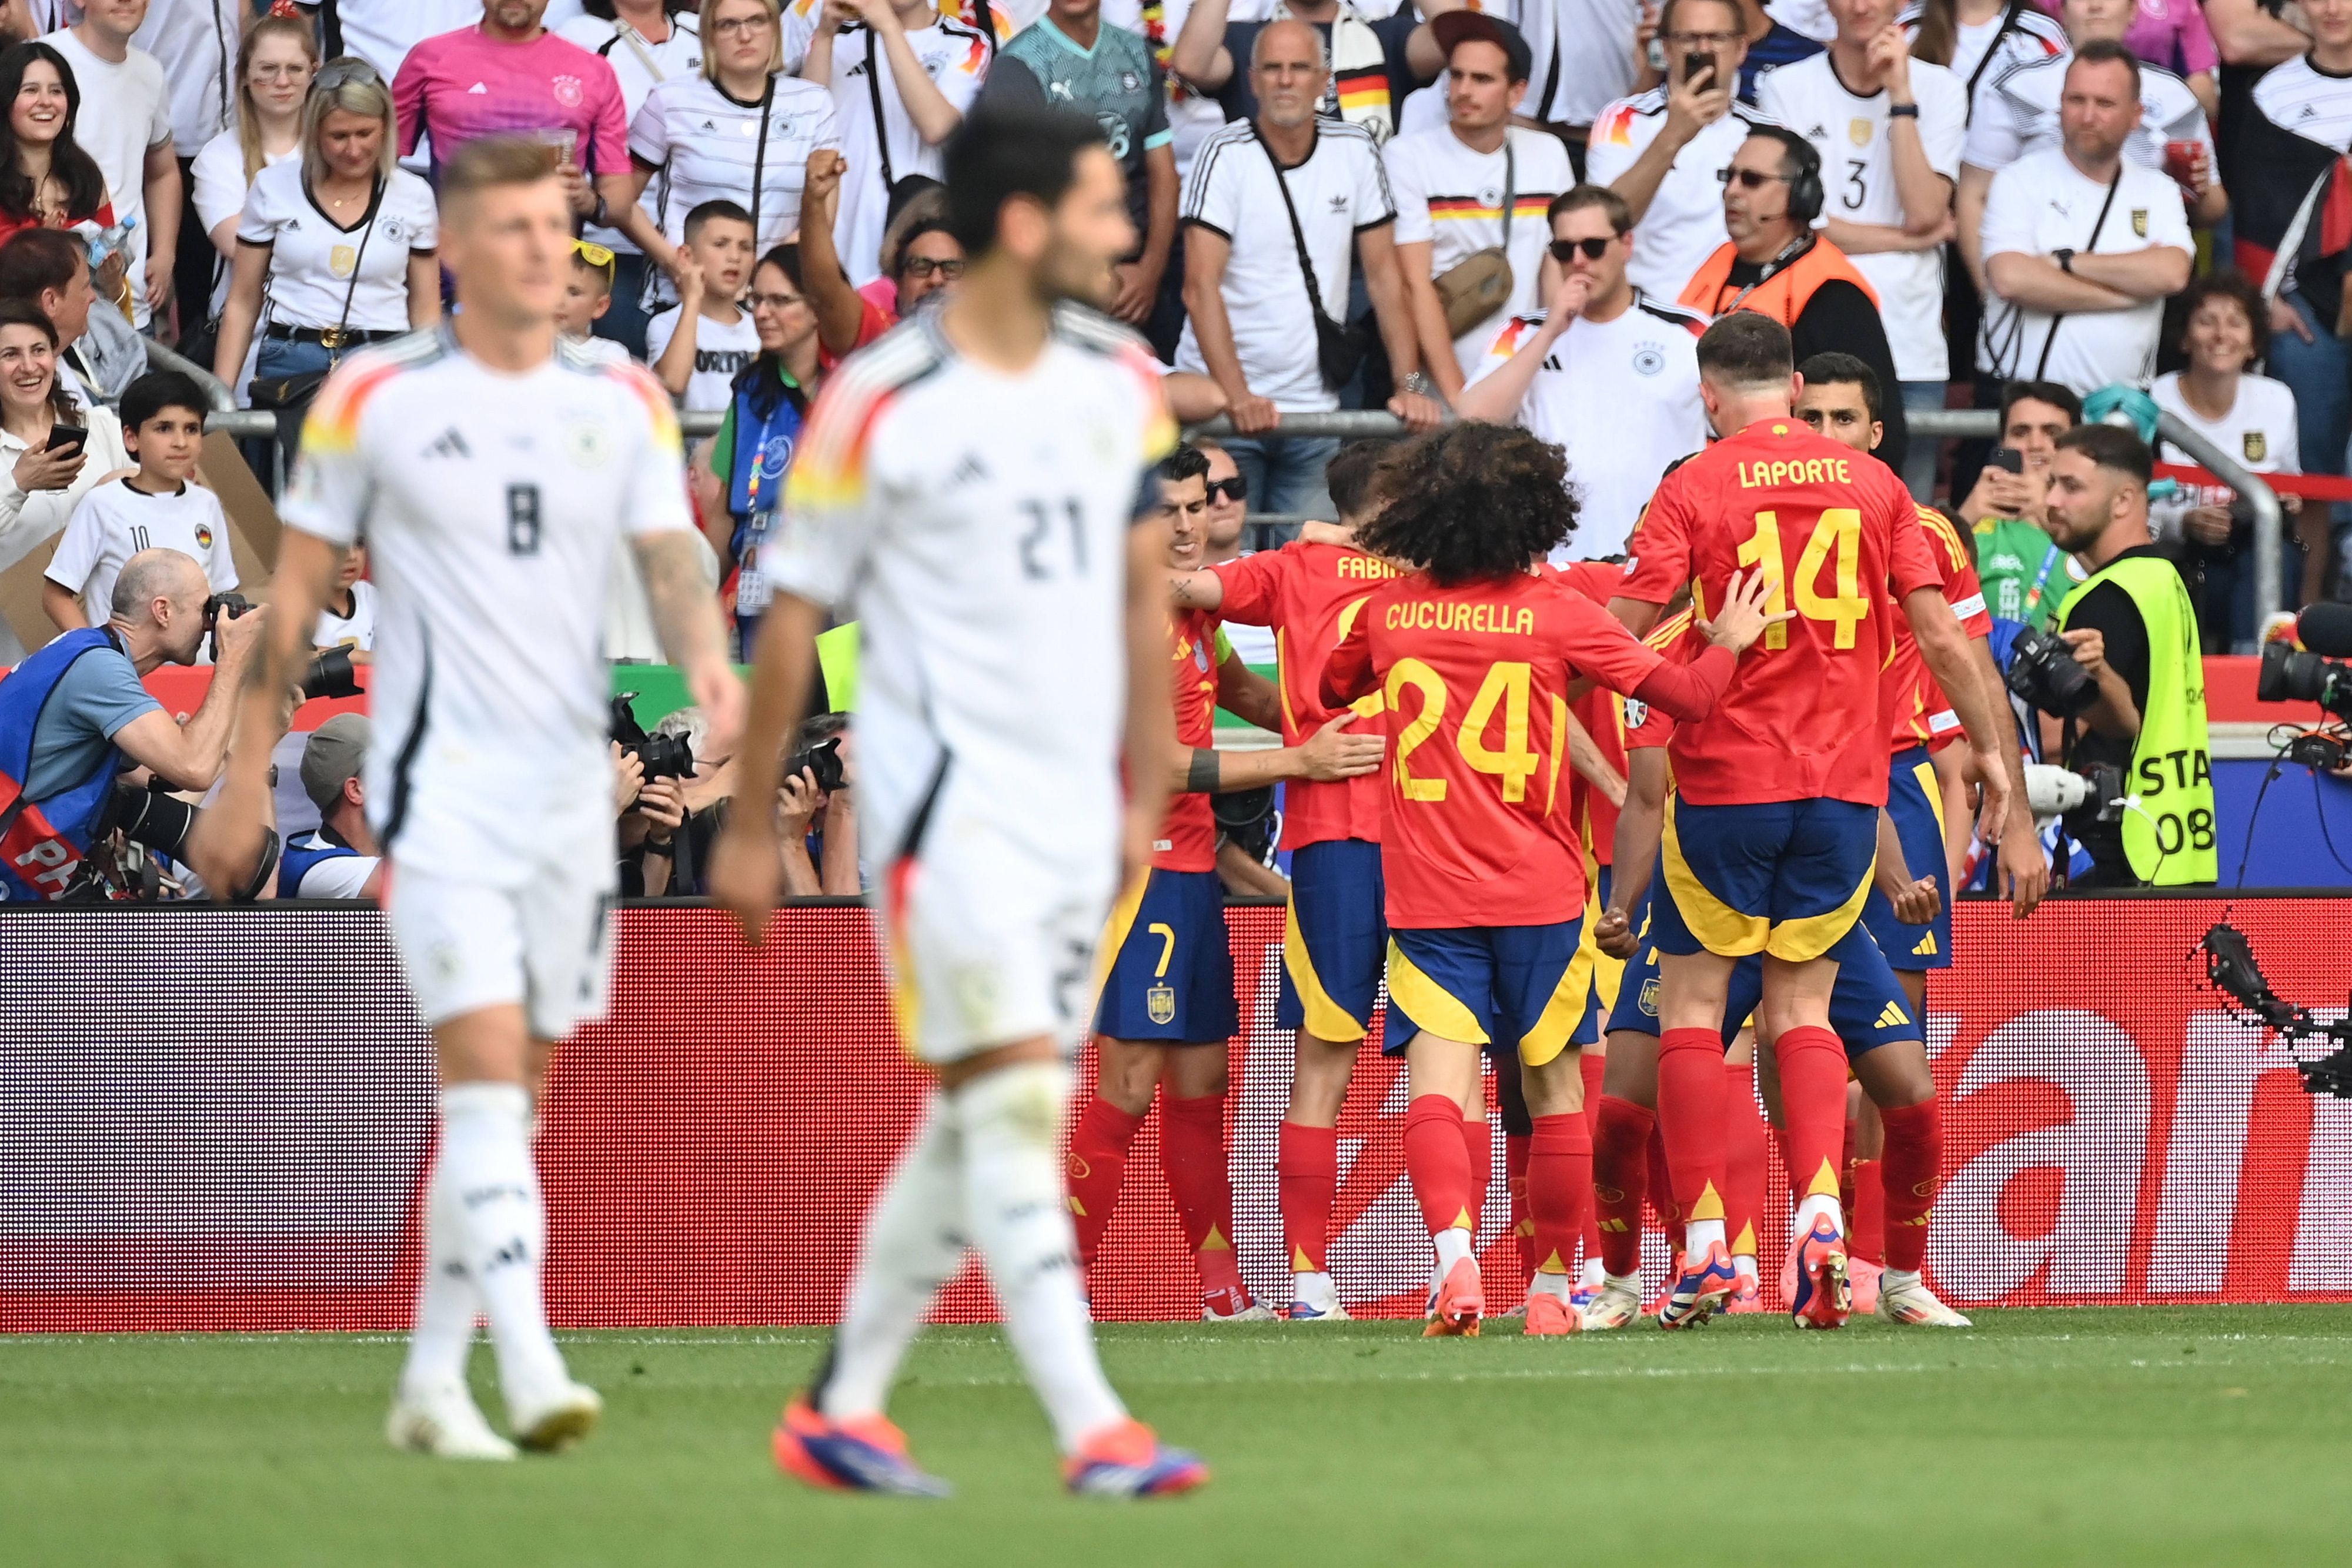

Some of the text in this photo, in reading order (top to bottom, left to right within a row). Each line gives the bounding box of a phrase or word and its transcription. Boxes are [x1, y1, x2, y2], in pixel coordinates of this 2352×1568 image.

[1843, 160, 1866, 210] 3
[1738, 458, 1852, 489] LAPORTE
[505, 482, 540, 557] 8
[1016, 498, 1089, 580] 21
[1737, 508, 1869, 650] 14
[1386, 602, 1534, 636] CUCURELLA
[1385, 656, 1541, 803] 24
[2140, 750, 2212, 797] STA
[2156, 808, 2215, 855] 08
[1148, 922, 1175, 978] 7
